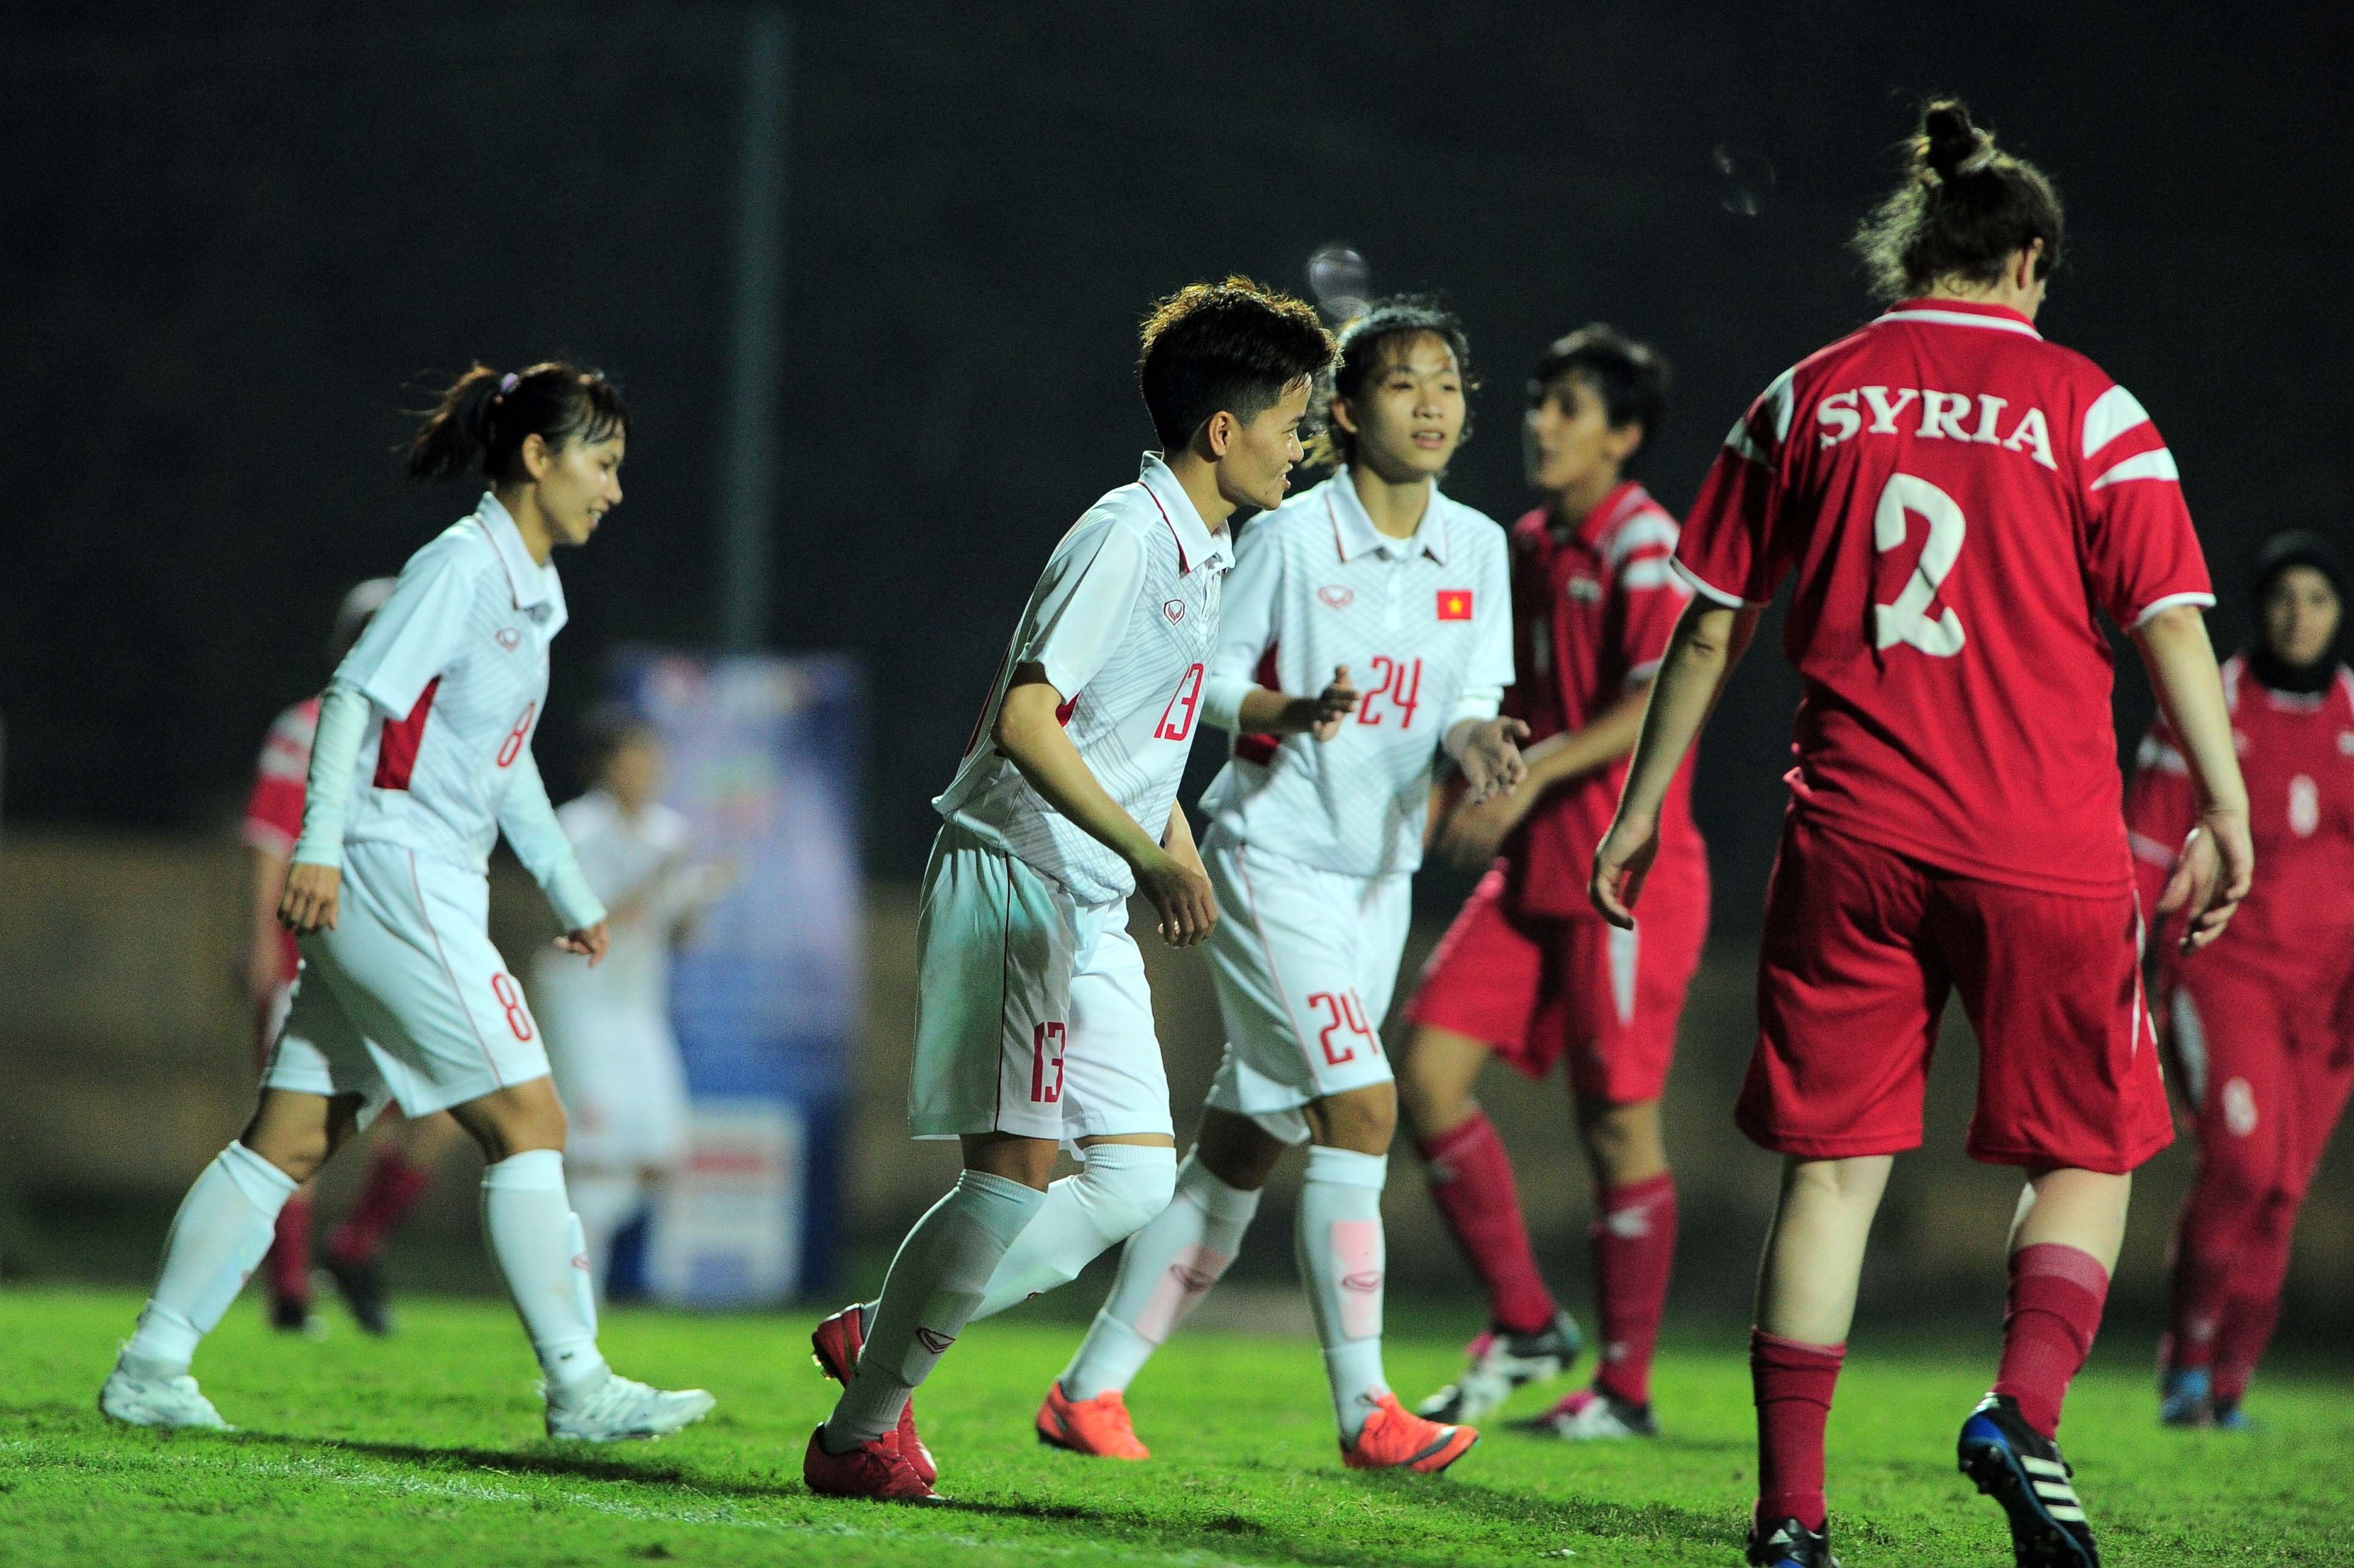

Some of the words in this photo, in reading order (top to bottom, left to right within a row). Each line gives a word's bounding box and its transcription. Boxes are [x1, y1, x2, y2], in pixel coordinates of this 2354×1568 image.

[1817, 386, 2058, 471] SYRIA
[1875, 473, 1966, 657] 2
[1153, 663, 1204, 742] 13
[1358, 656, 1422, 730] 24
[497, 700, 536, 768] 8
[491, 972, 532, 1041] 8
[1308, 987, 1379, 1066] 24
[1031, 1021, 1066, 1103] 13
